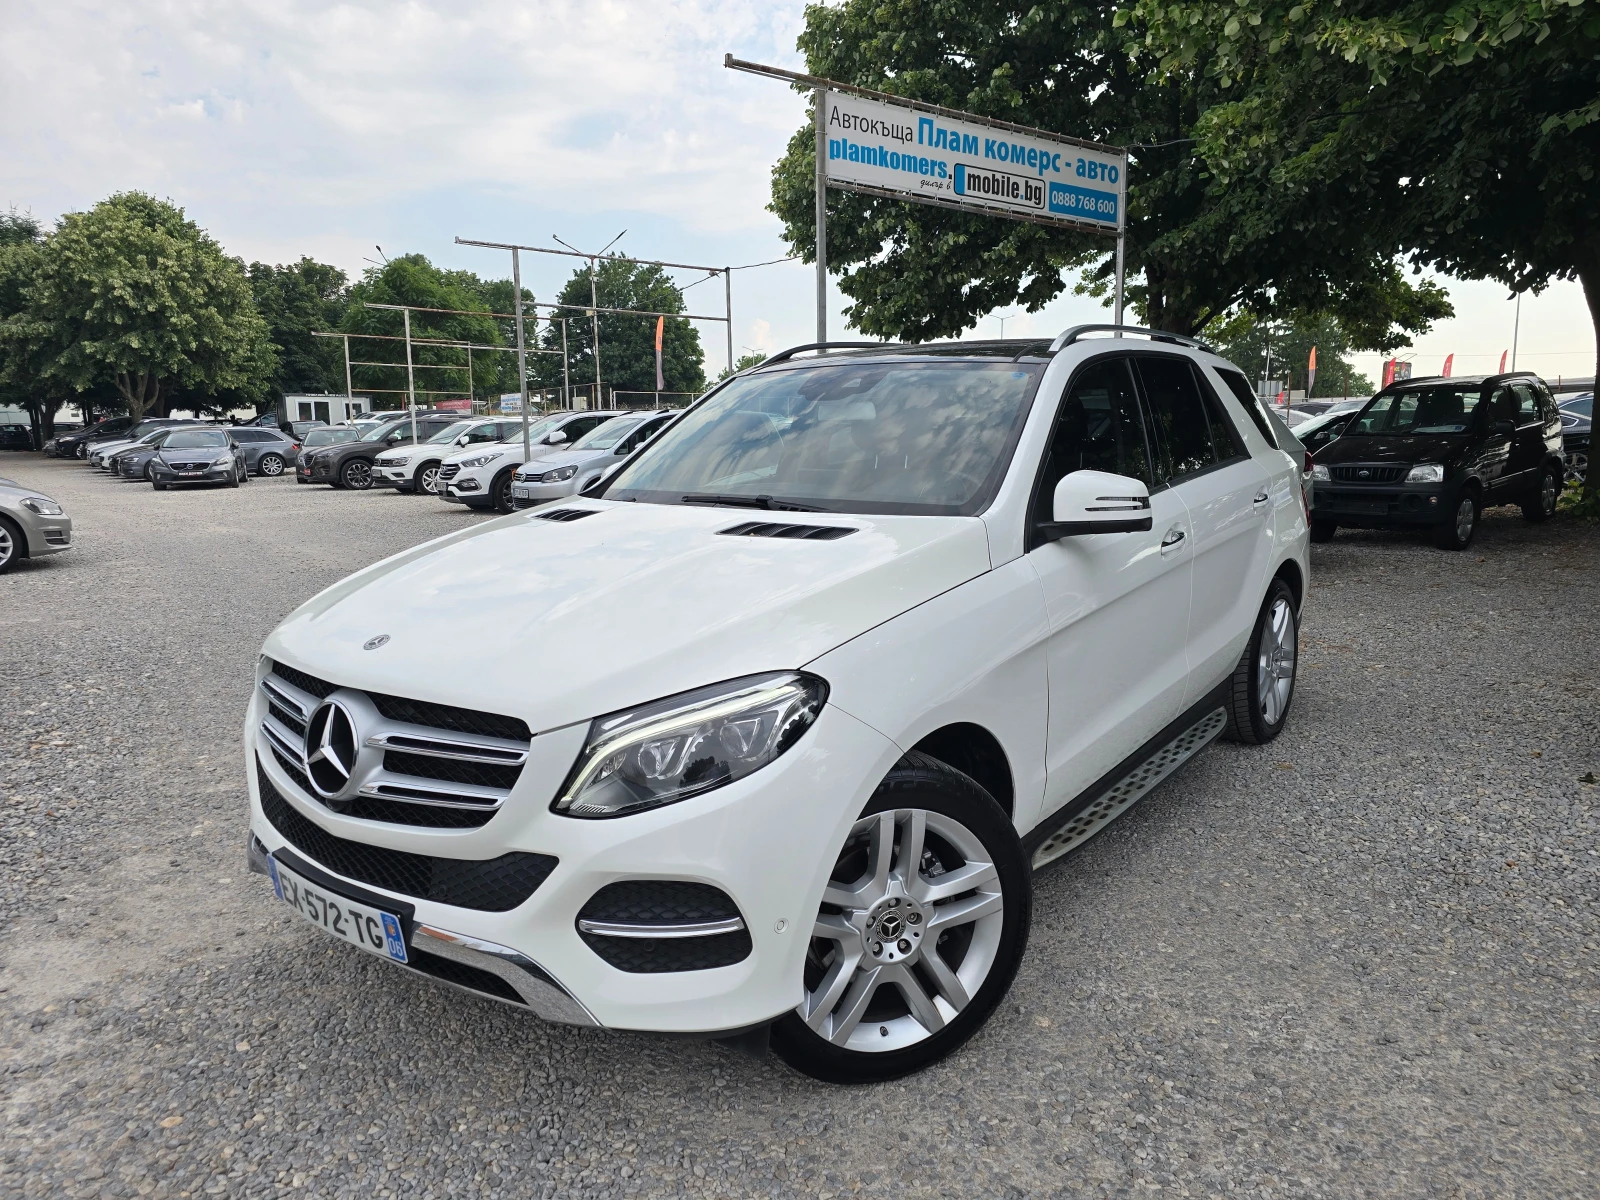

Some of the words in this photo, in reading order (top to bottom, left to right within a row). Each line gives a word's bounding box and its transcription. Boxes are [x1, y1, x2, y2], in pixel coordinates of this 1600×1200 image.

[829, 105, 913, 144] Автокъща
[918, 116, 979, 156] Плам
[984, 138, 1060, 176] комерс
[1075, 157, 1120, 184] авто
[966, 172, 1042, 206] mobile.bg
[1051, 190, 1076, 208] 0888
[1077, 195, 1096, 211] 768
[1097, 199, 1115, 215] 600
[278, 871, 384, 950] EX-572-TG
[387, 937, 404, 957] 06
